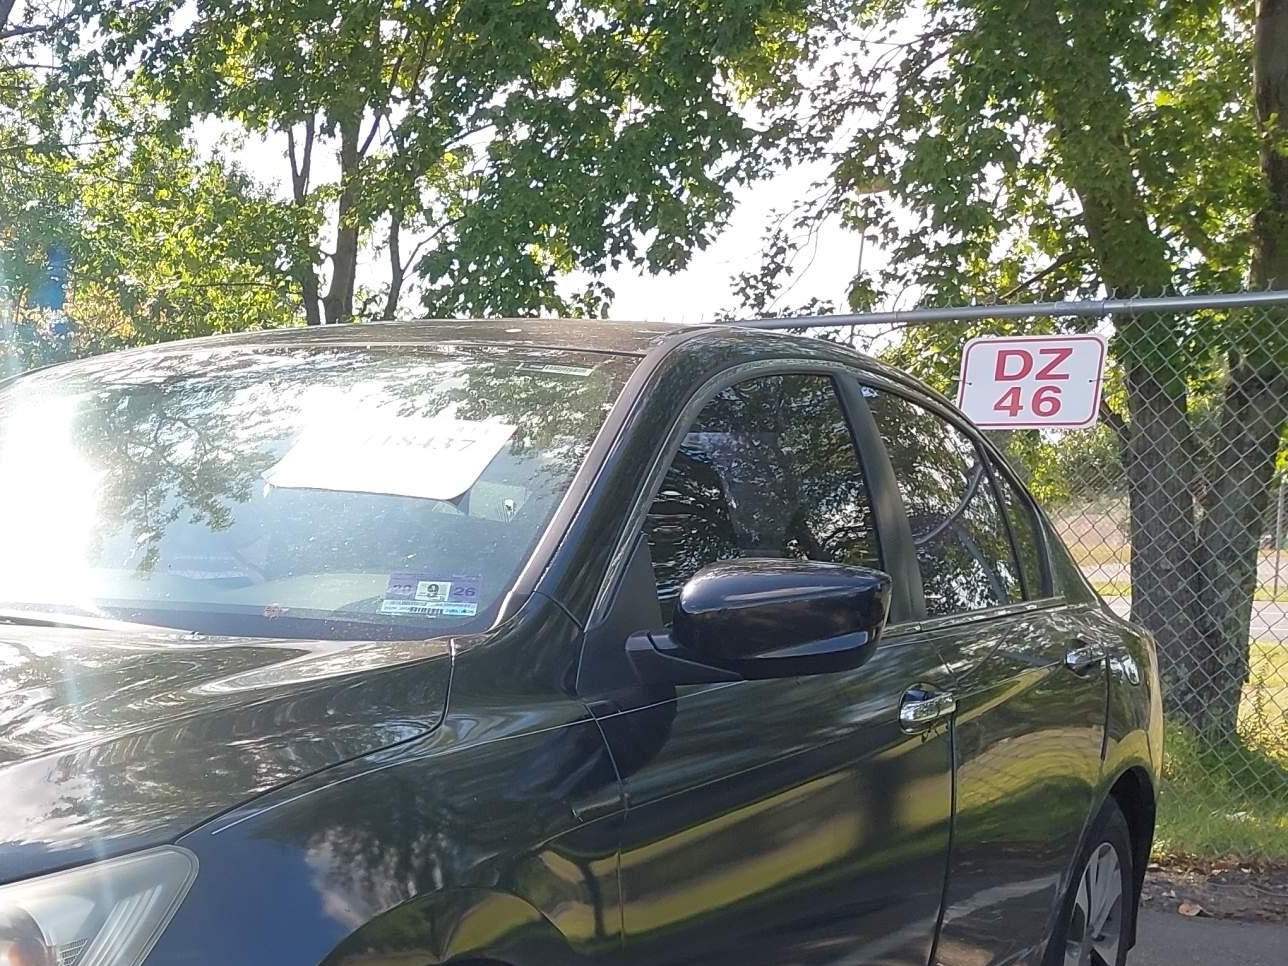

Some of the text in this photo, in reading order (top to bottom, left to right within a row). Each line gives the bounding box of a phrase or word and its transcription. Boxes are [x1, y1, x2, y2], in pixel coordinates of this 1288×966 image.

[994, 347, 1073, 381] DZ
[993, 385, 1062, 417] 46
[453, 587, 476, 597] 26
